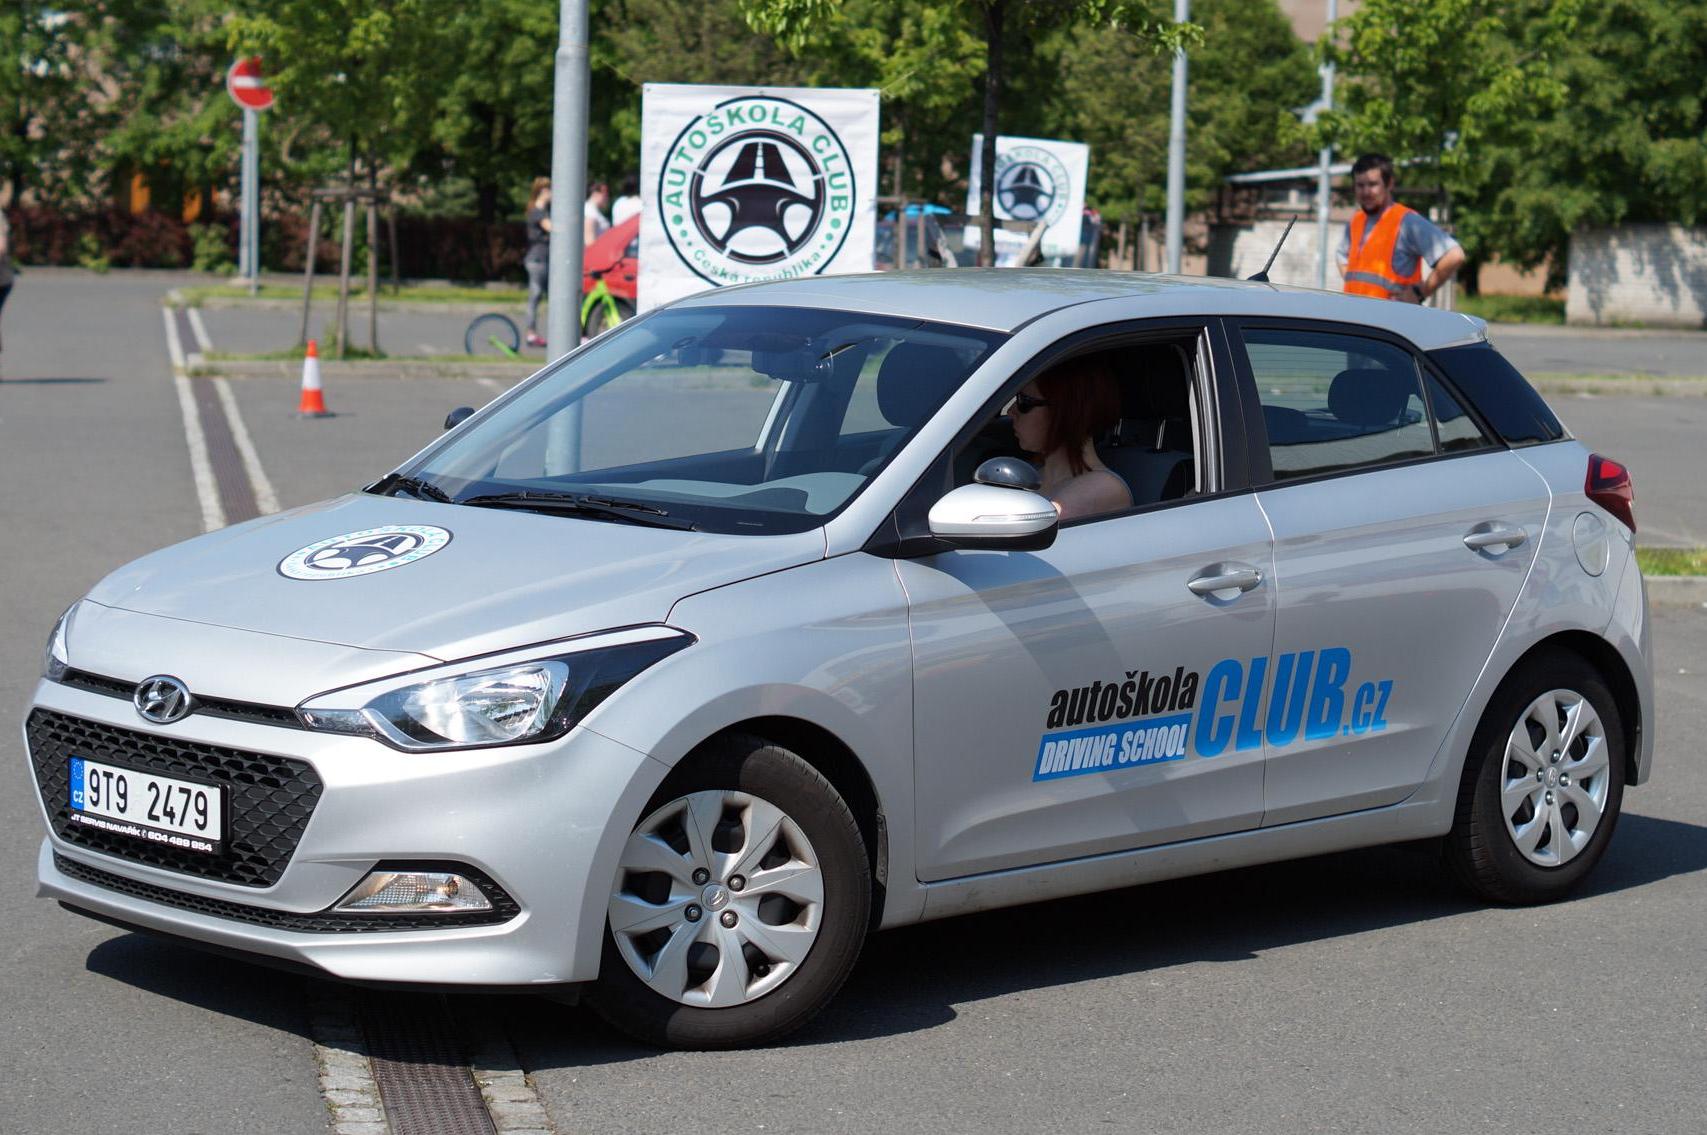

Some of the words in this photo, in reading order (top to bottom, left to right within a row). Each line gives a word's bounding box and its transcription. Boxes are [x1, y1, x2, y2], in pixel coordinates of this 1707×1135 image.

[665, 104, 806, 208] AUTOŠKOLA
[812, 134, 848, 212] CLUB
[1046, 665, 1199, 730] autoškola
[1038, 731, 1117, 775] DRIVING
[1117, 723, 1189, 764] SCHOOL
[73, 790, 84, 804] CZ
[89, 768, 128, 814] 9T9
[147, 781, 208, 831] 2479
